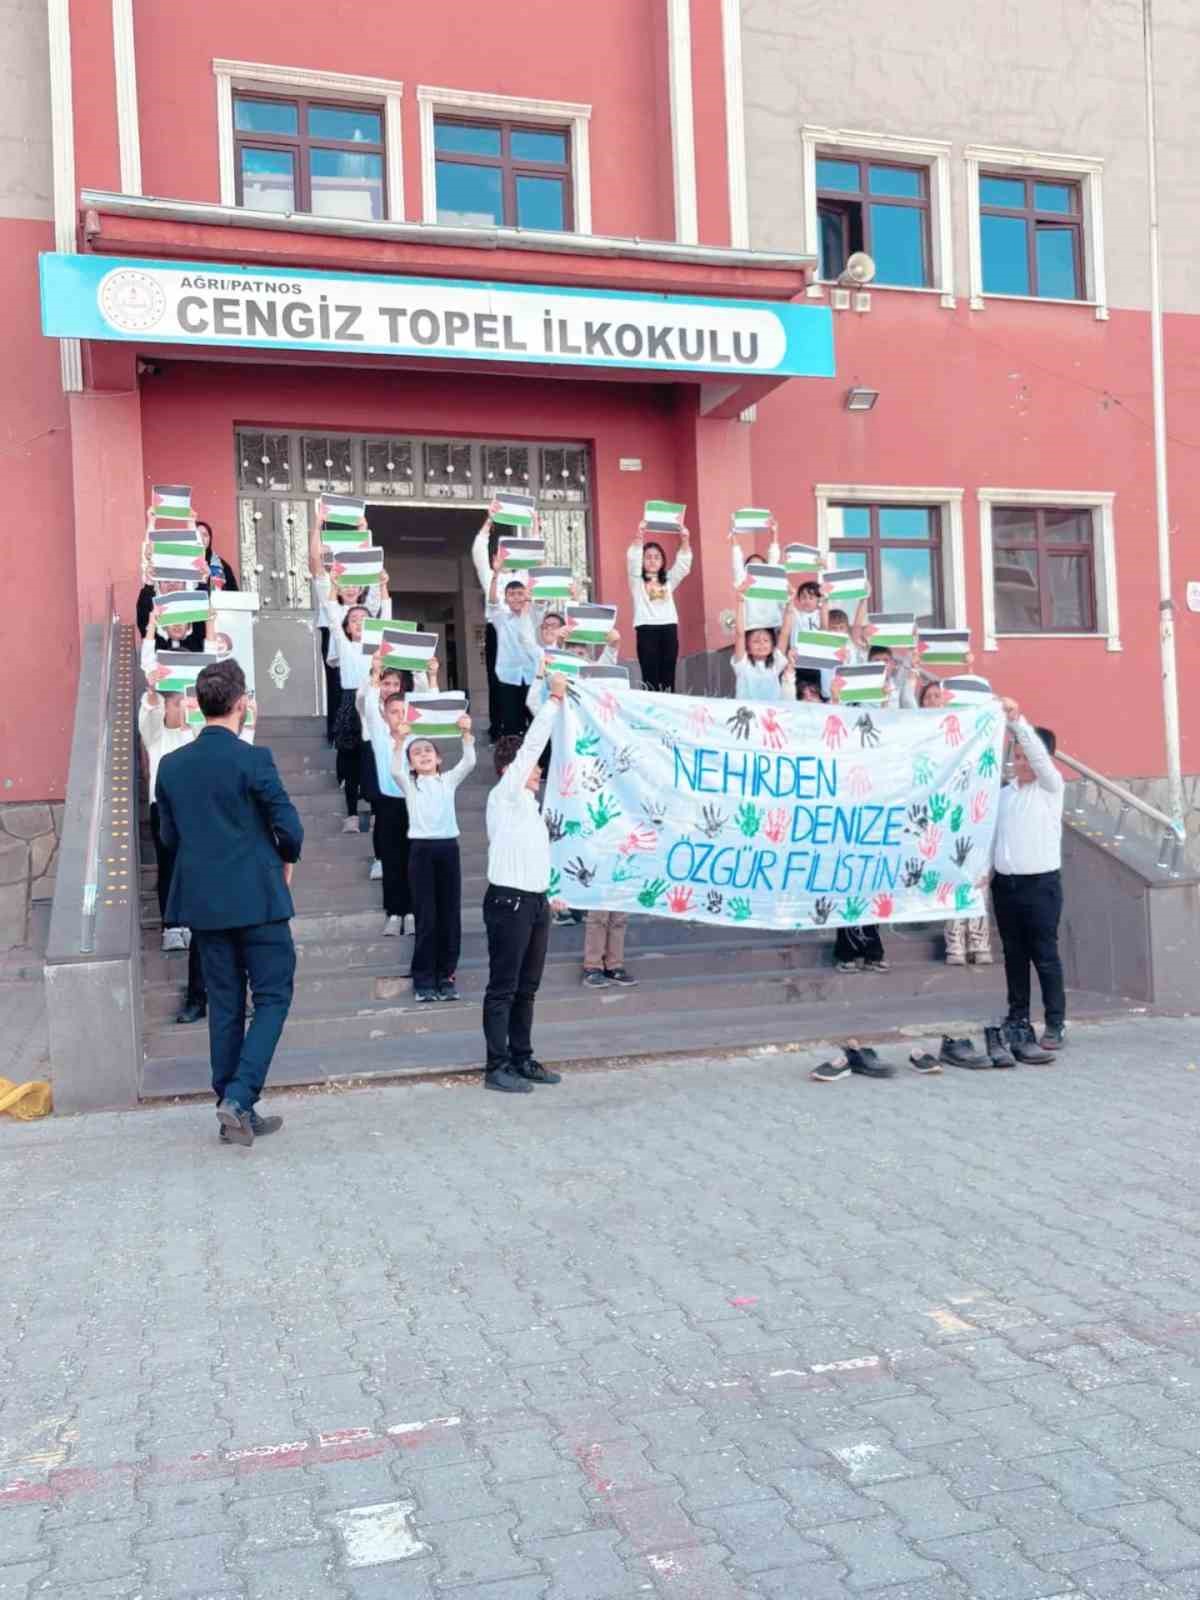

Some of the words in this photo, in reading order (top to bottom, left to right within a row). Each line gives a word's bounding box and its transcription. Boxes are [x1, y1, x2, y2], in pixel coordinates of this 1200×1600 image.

[180, 276, 302, 295] AĞRI/PATNOS
[176, 294, 365, 341] CENGİZ
[379, 307, 527, 351] TOPEL
[543, 309, 759, 365] İLKOKULU
[666, 835, 775, 891] ÖZGÜR
